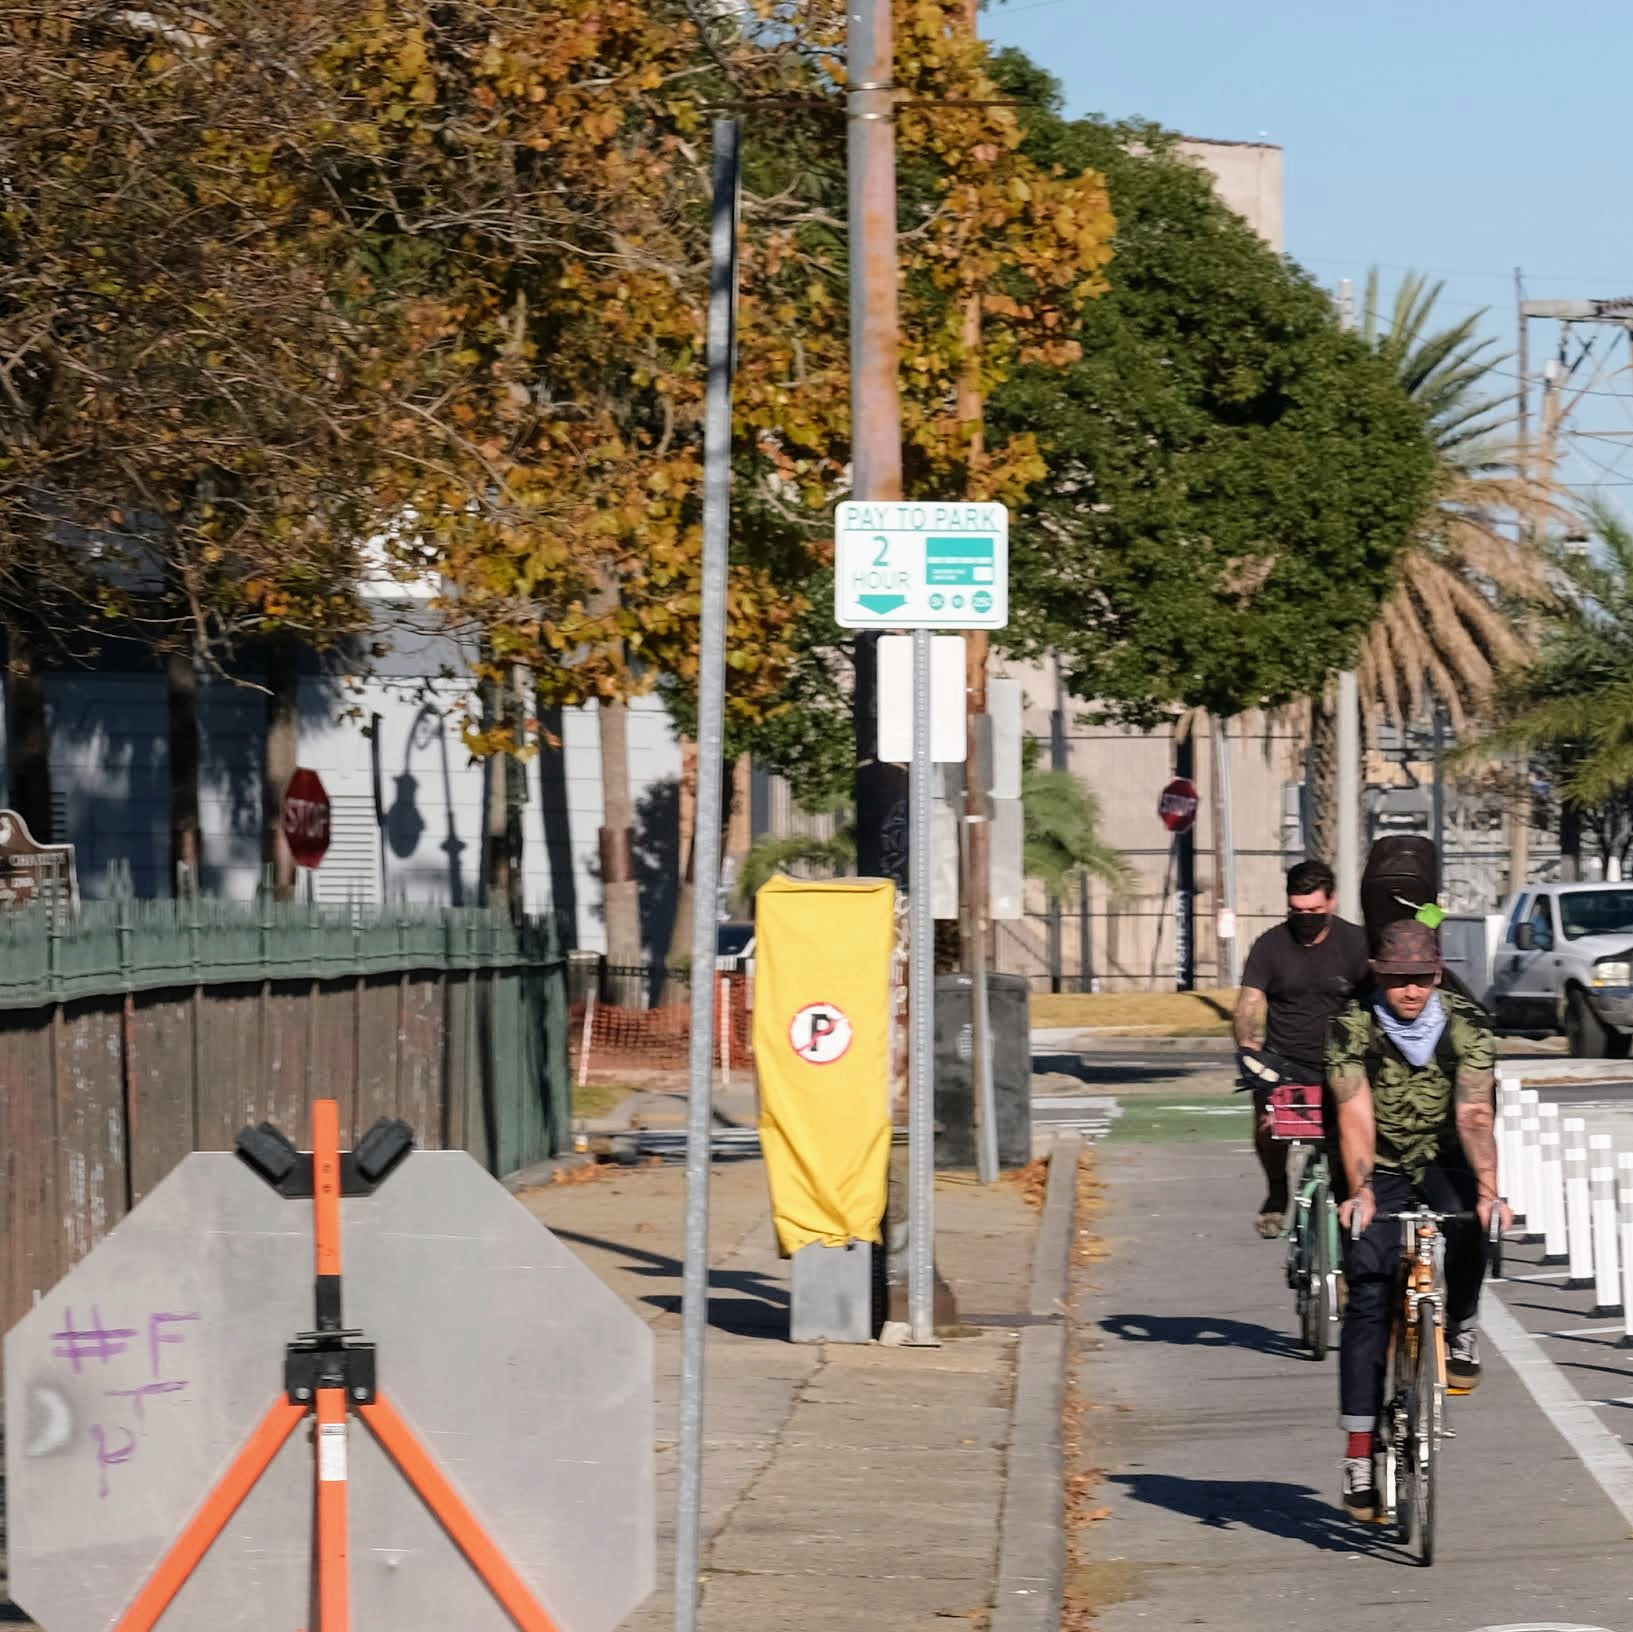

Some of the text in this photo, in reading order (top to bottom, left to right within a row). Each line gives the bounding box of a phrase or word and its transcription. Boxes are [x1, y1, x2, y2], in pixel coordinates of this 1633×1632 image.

[846, 507, 995, 530] PAY TO PARK
[872, 535, 889, 567] 2
[853, 571, 911, 589] HOUR
[286, 798, 328, 838] STOP
